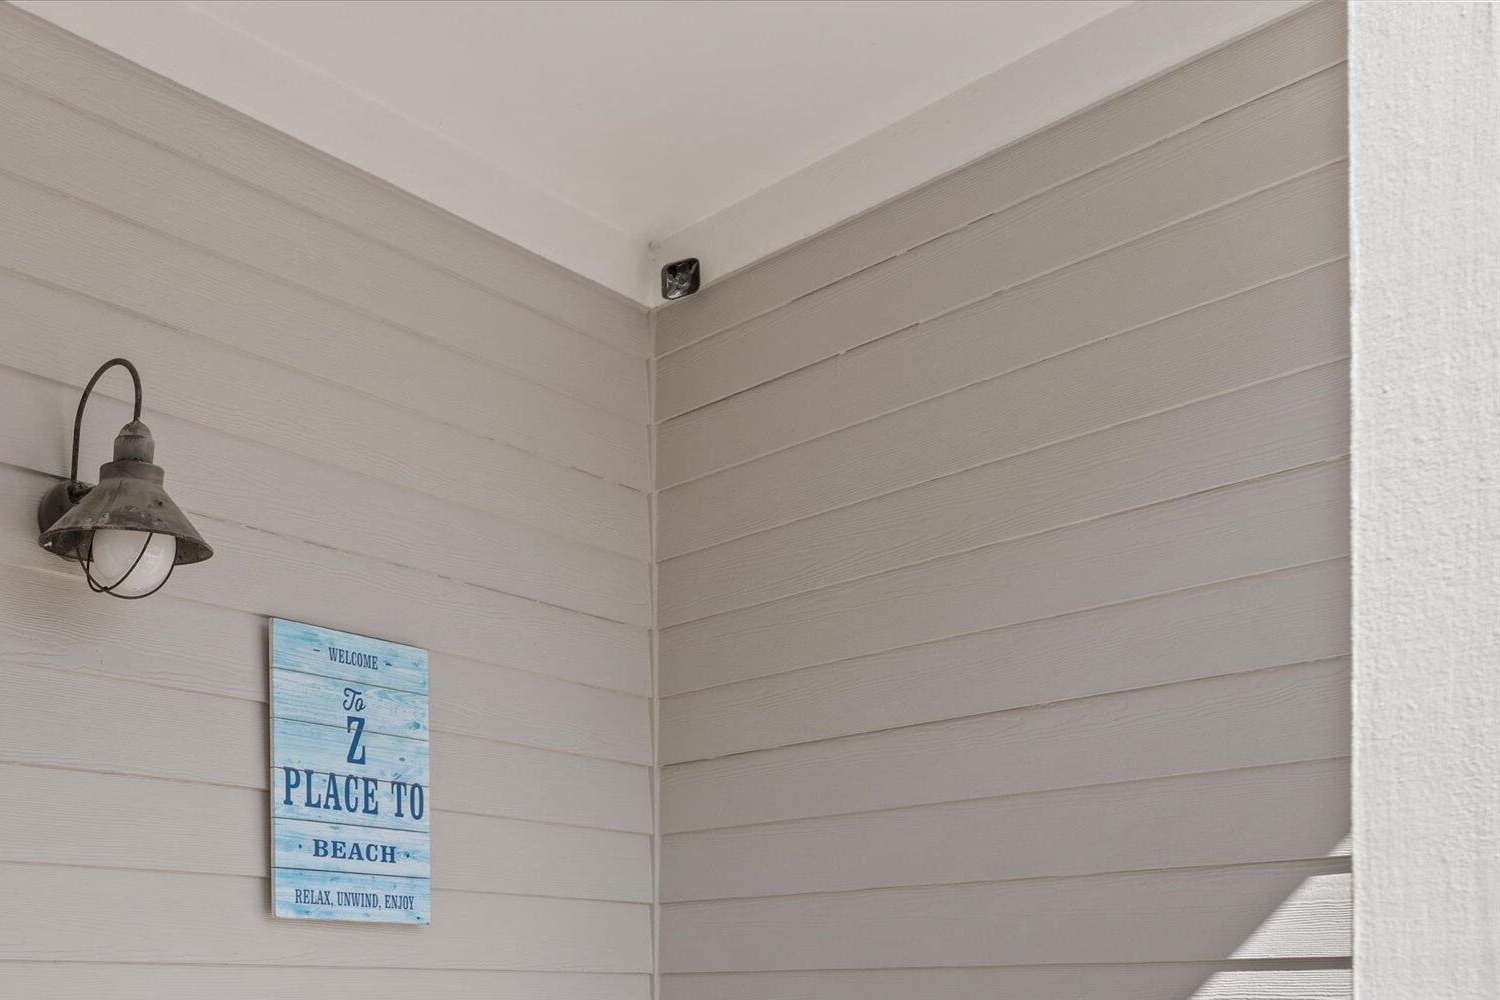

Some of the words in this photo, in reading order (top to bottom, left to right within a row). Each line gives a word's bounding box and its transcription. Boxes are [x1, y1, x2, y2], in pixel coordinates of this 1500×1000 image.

[328, 646, 378, 670] WELCOME
[343, 687, 365, 712] To
[346, 715, 366, 765] Z
[283, 766, 379, 815] PLACE
[391, 780, 424, 820] TO
[312, 838, 396, 864] BEACH
[295, 888, 334, 907] RELAX,
[337, 891, 382, 910] UNWIND,
[384, 894, 414, 911] ENJOY
